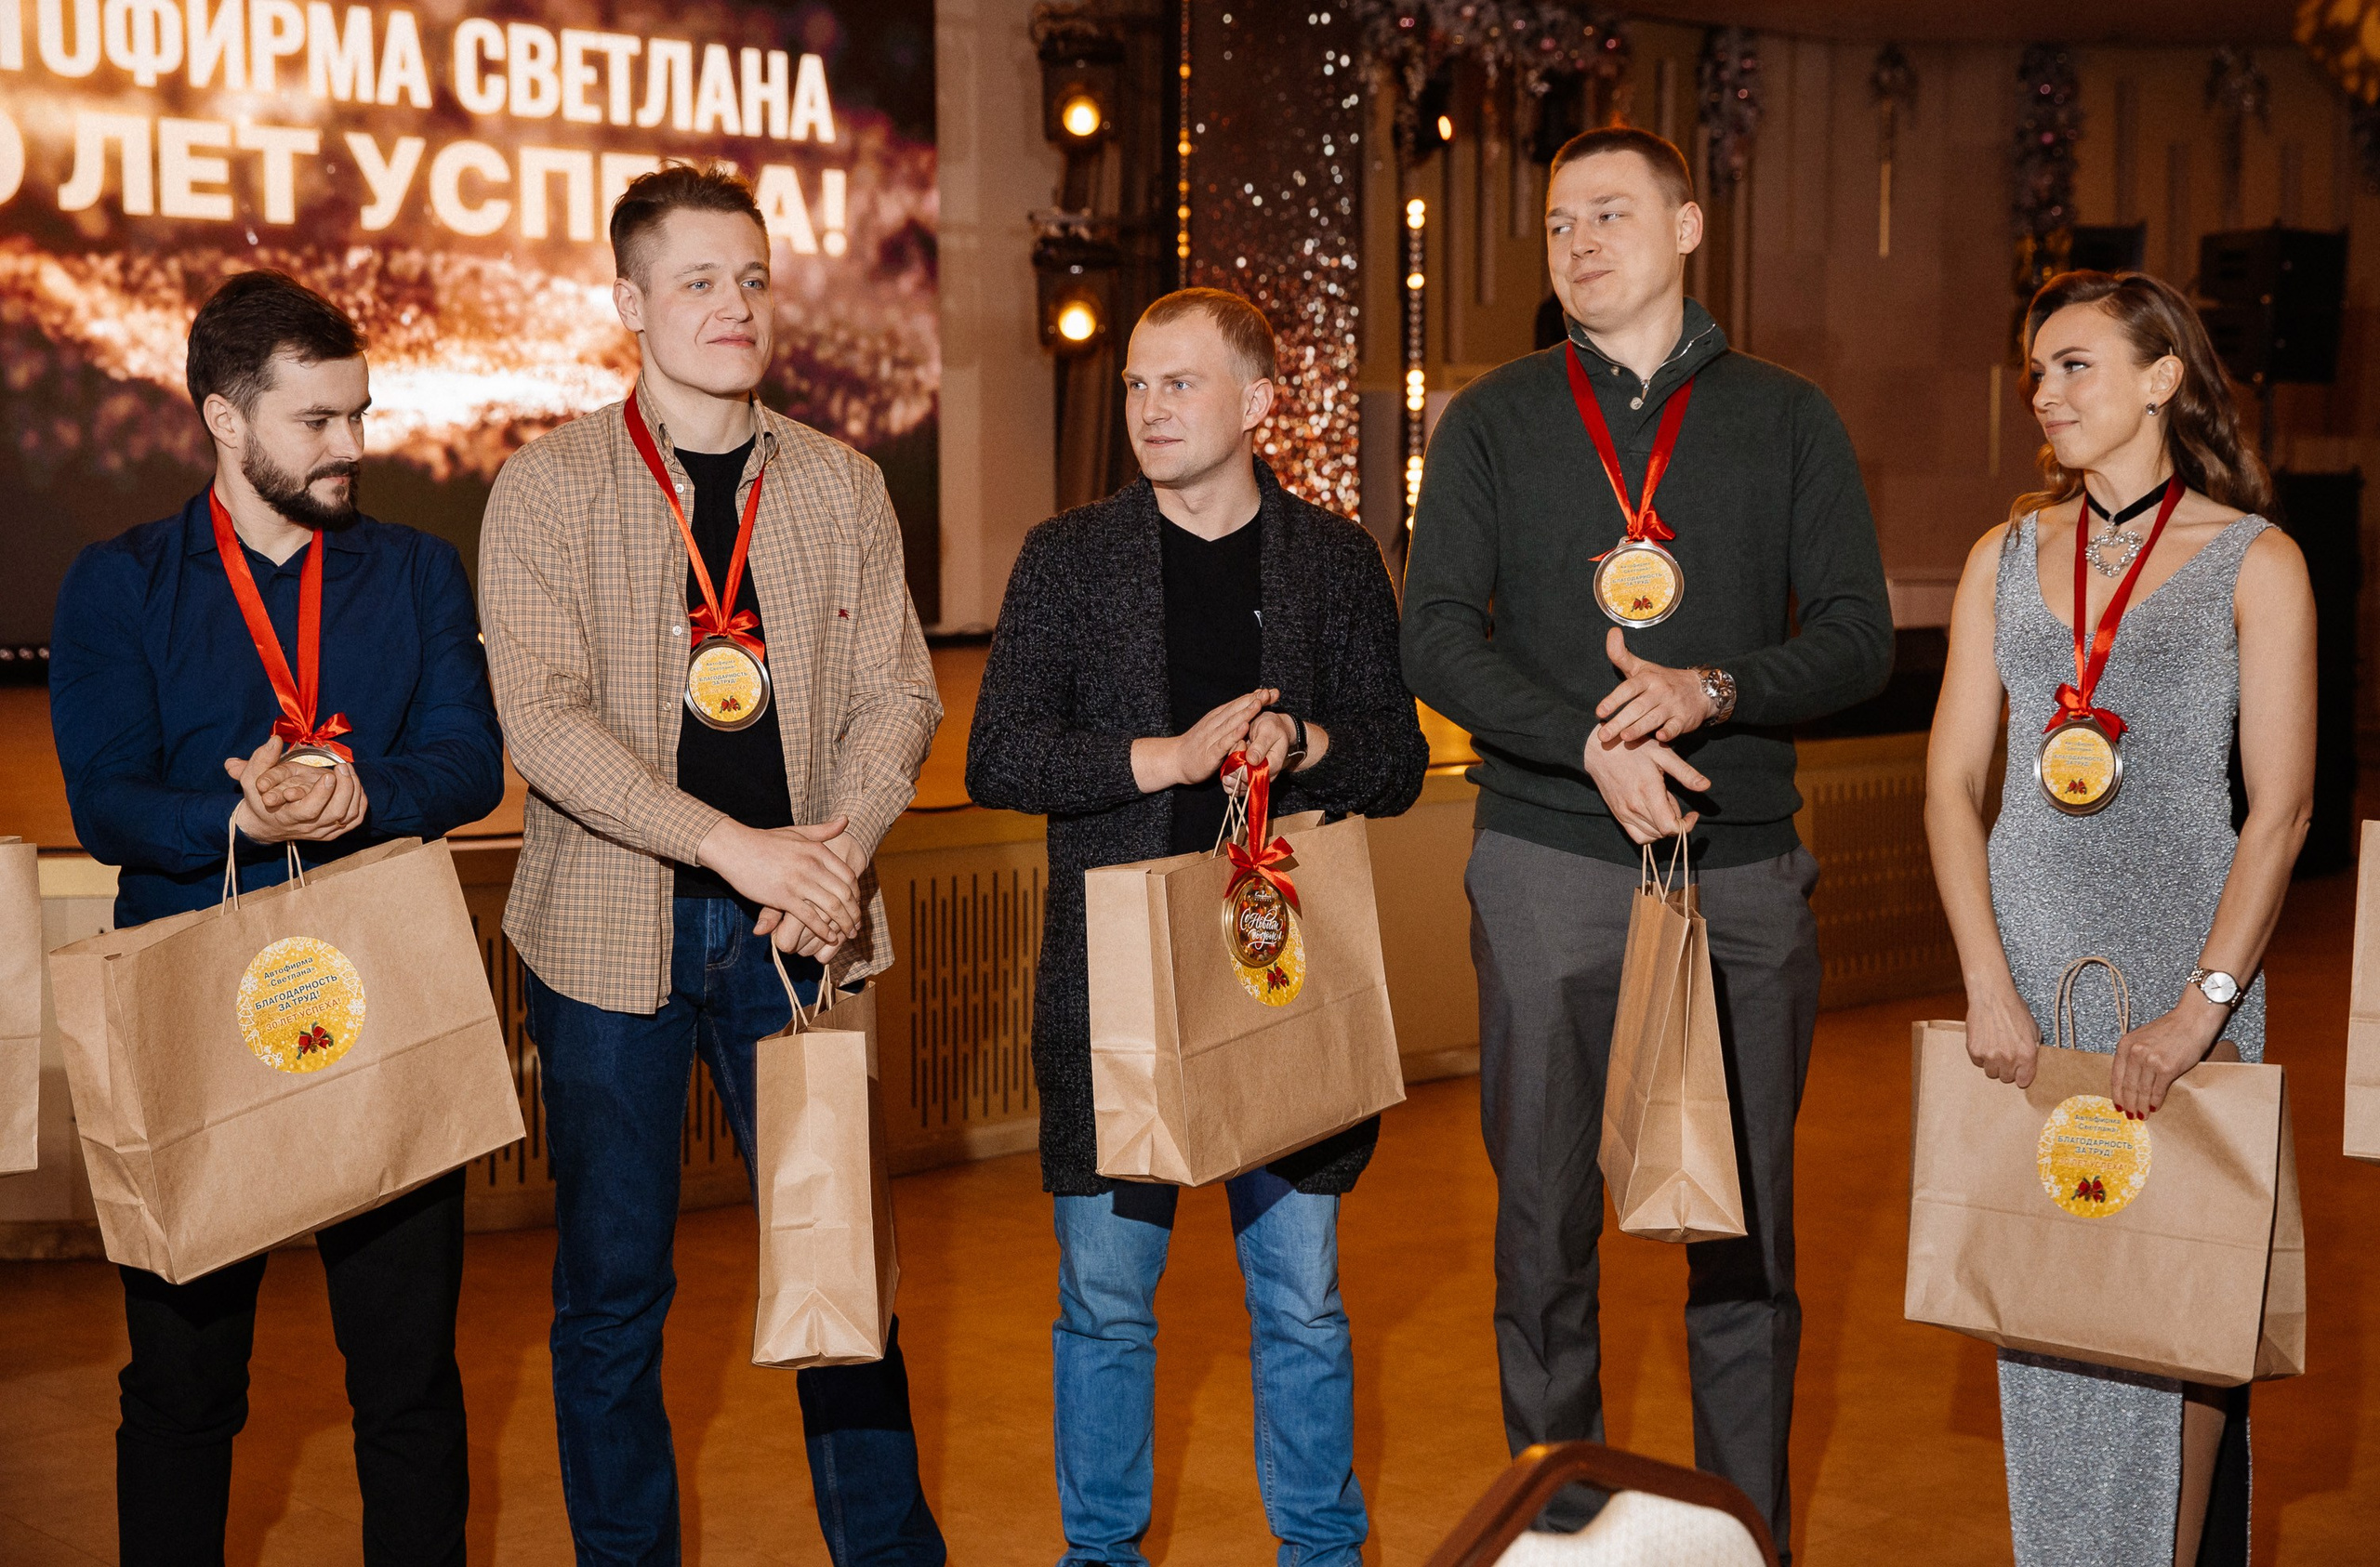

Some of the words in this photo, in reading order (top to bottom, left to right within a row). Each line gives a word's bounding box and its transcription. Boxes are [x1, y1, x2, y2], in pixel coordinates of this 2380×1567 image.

[454, 17, 837, 144] СВЕТЛАНА
[58, 109, 321, 225] ЛЕТ
[343, 131, 849, 258] УСПА!
[264, 957, 313, 979] Автофирма
[255, 975, 337, 1009] БЛАГОДАРНОСТЬ
[278, 1002, 291, 1011] ЗА
[292, 991, 320, 1006] ТРУД!
[266, 1021, 278, 1031] 30
[279, 1014, 298, 1027] ЛЕТ
[299, 998, 341, 1018] УСПЕХА!
[2057, 1136, 2133, 1150] БЛАГОДАРНОСТЬ
[2088, 1148, 2113, 1157] ТРУД!
